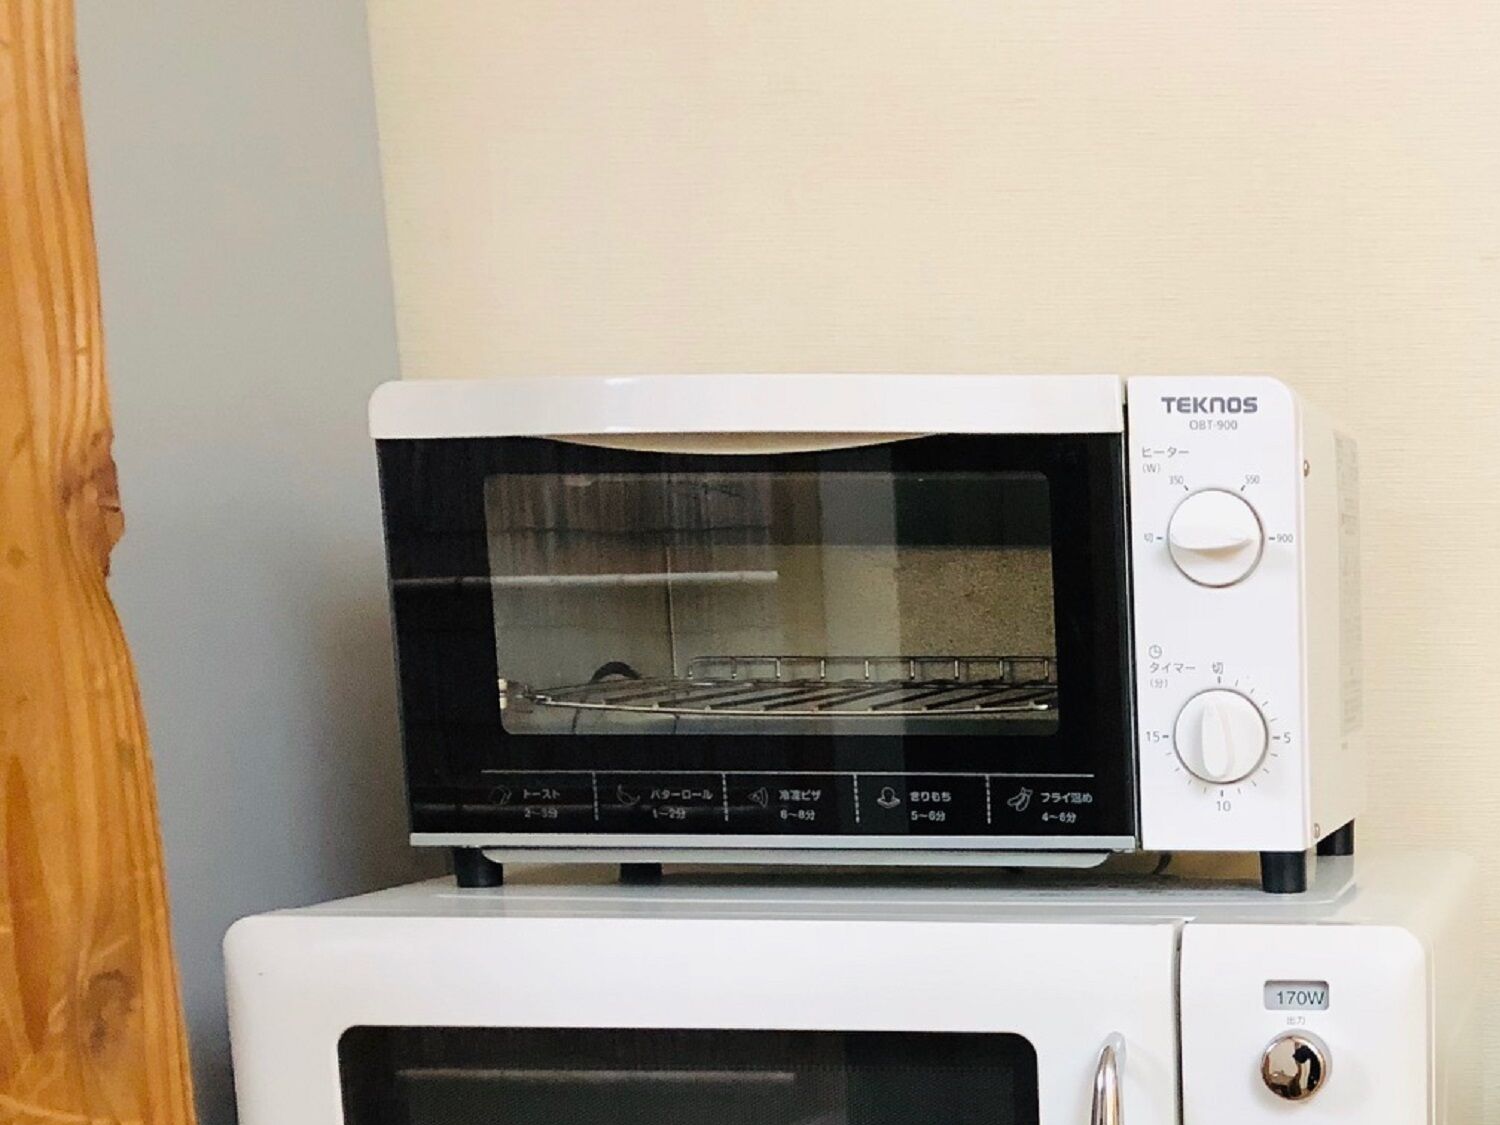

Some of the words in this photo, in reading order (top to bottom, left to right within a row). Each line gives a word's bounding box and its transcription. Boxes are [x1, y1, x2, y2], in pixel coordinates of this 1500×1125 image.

[1161, 396, 1258, 414] TEKNOS
[1142, 446, 1189, 458] ヒーター
[1277, 534, 1293, 543] 900
[1150, 662, 1196, 674] タイマー
[1212, 662, 1224, 675] 切
[1146, 731, 1160, 743] 15
[1283, 732, 1291, 744] 5
[523, 789, 561, 800] トースト
[1216, 801, 1232, 812] 10
[1276, 991, 1325, 1005] 170W
